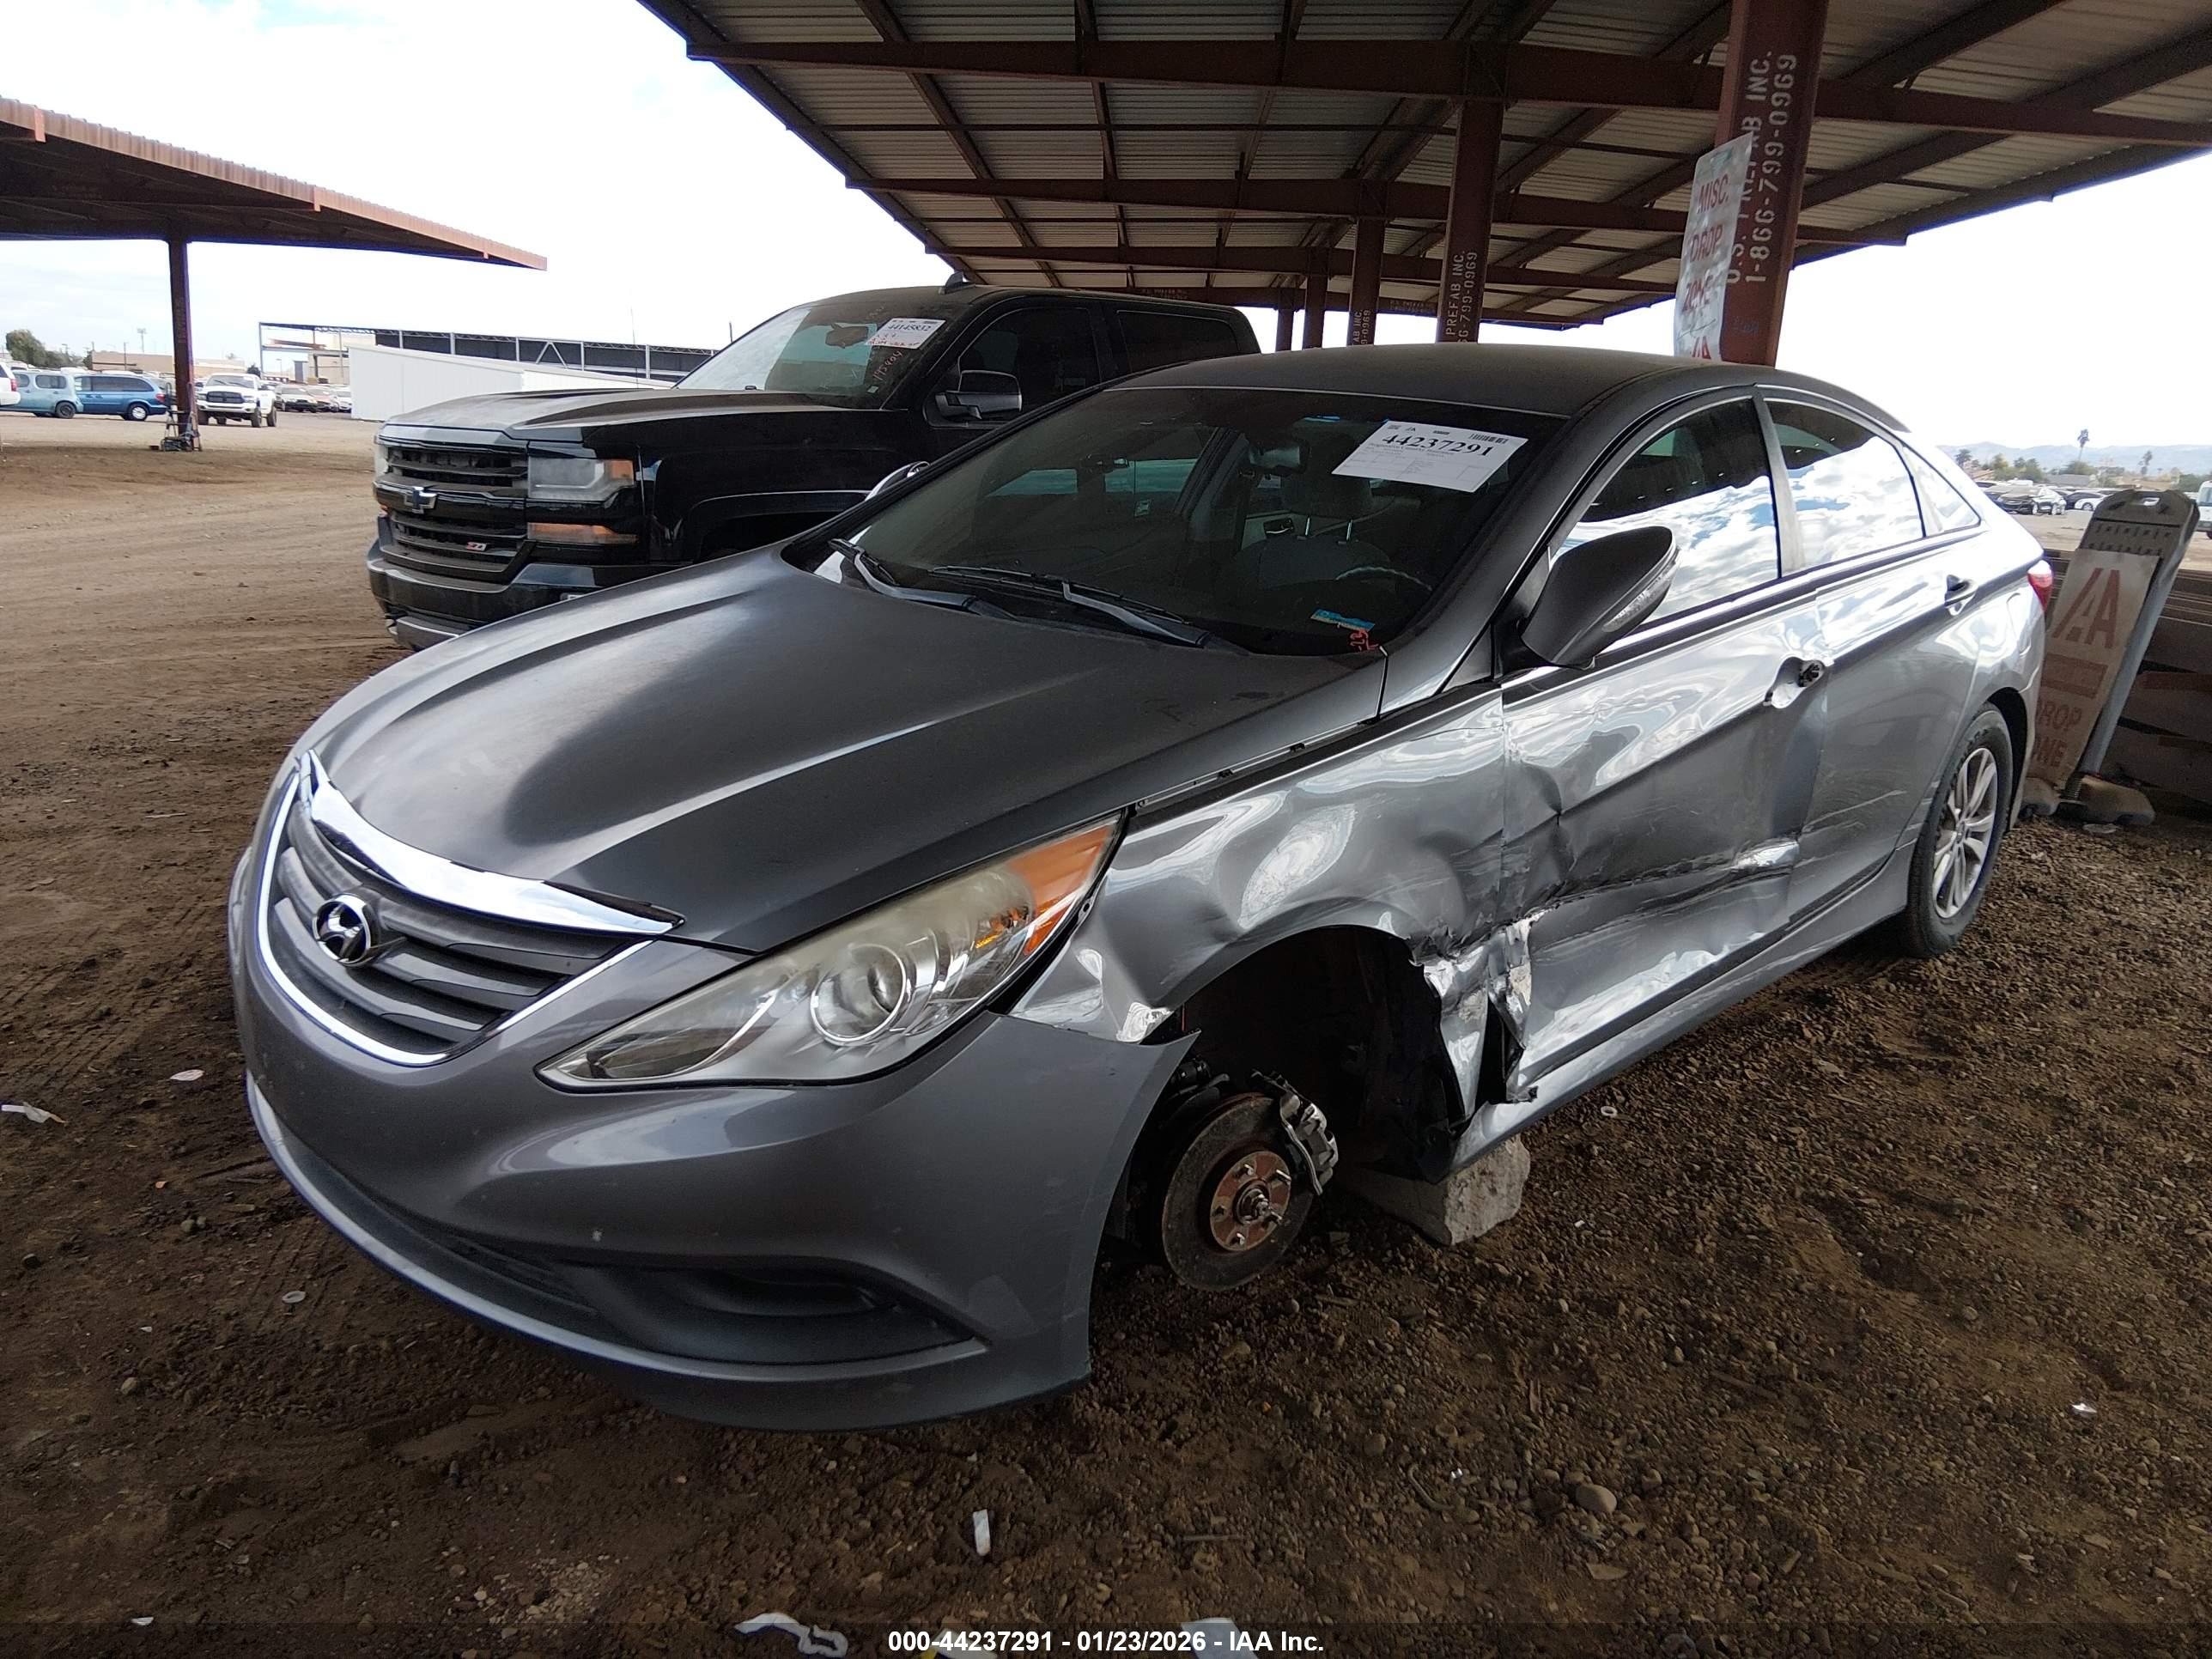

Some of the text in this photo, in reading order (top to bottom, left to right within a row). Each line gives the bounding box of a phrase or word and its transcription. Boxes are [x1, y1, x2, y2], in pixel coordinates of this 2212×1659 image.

[1745, 51, 1772, 101] INC.
[1745, 53, 1797, 283] 1-866-799-0969
[1445, 251, 1465, 336] PREFAB INC.
[1382, 434, 1494, 457] 44237291
